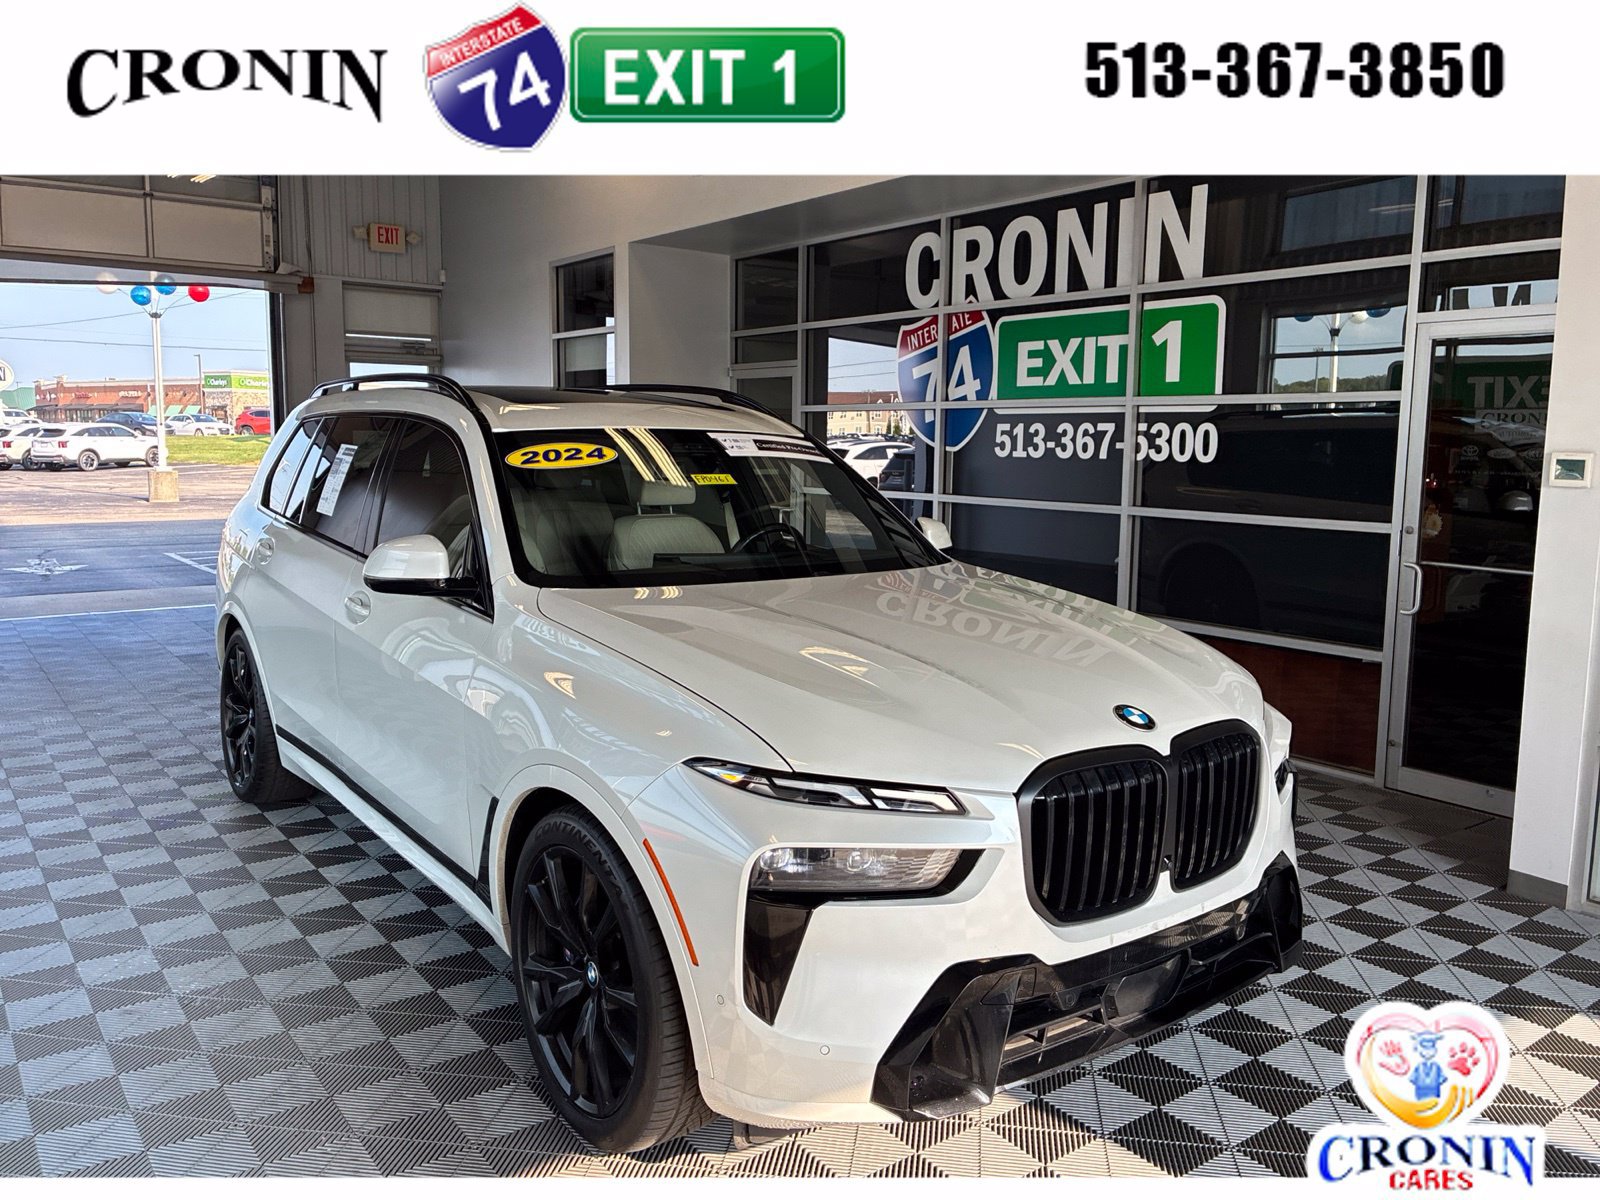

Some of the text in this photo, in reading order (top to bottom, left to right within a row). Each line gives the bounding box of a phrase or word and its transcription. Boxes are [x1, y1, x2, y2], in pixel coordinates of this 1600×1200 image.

[377, 225, 400, 245] EXIT
[905, 184, 1208, 309] CRONIN
[906, 312, 972, 351] INTERATE
[1016, 320, 1182, 387] EXIT 1
[911, 344, 982, 423] 74
[520, 447, 606, 465] 2024
[994, 422, 1219, 463] 513-367-5300
